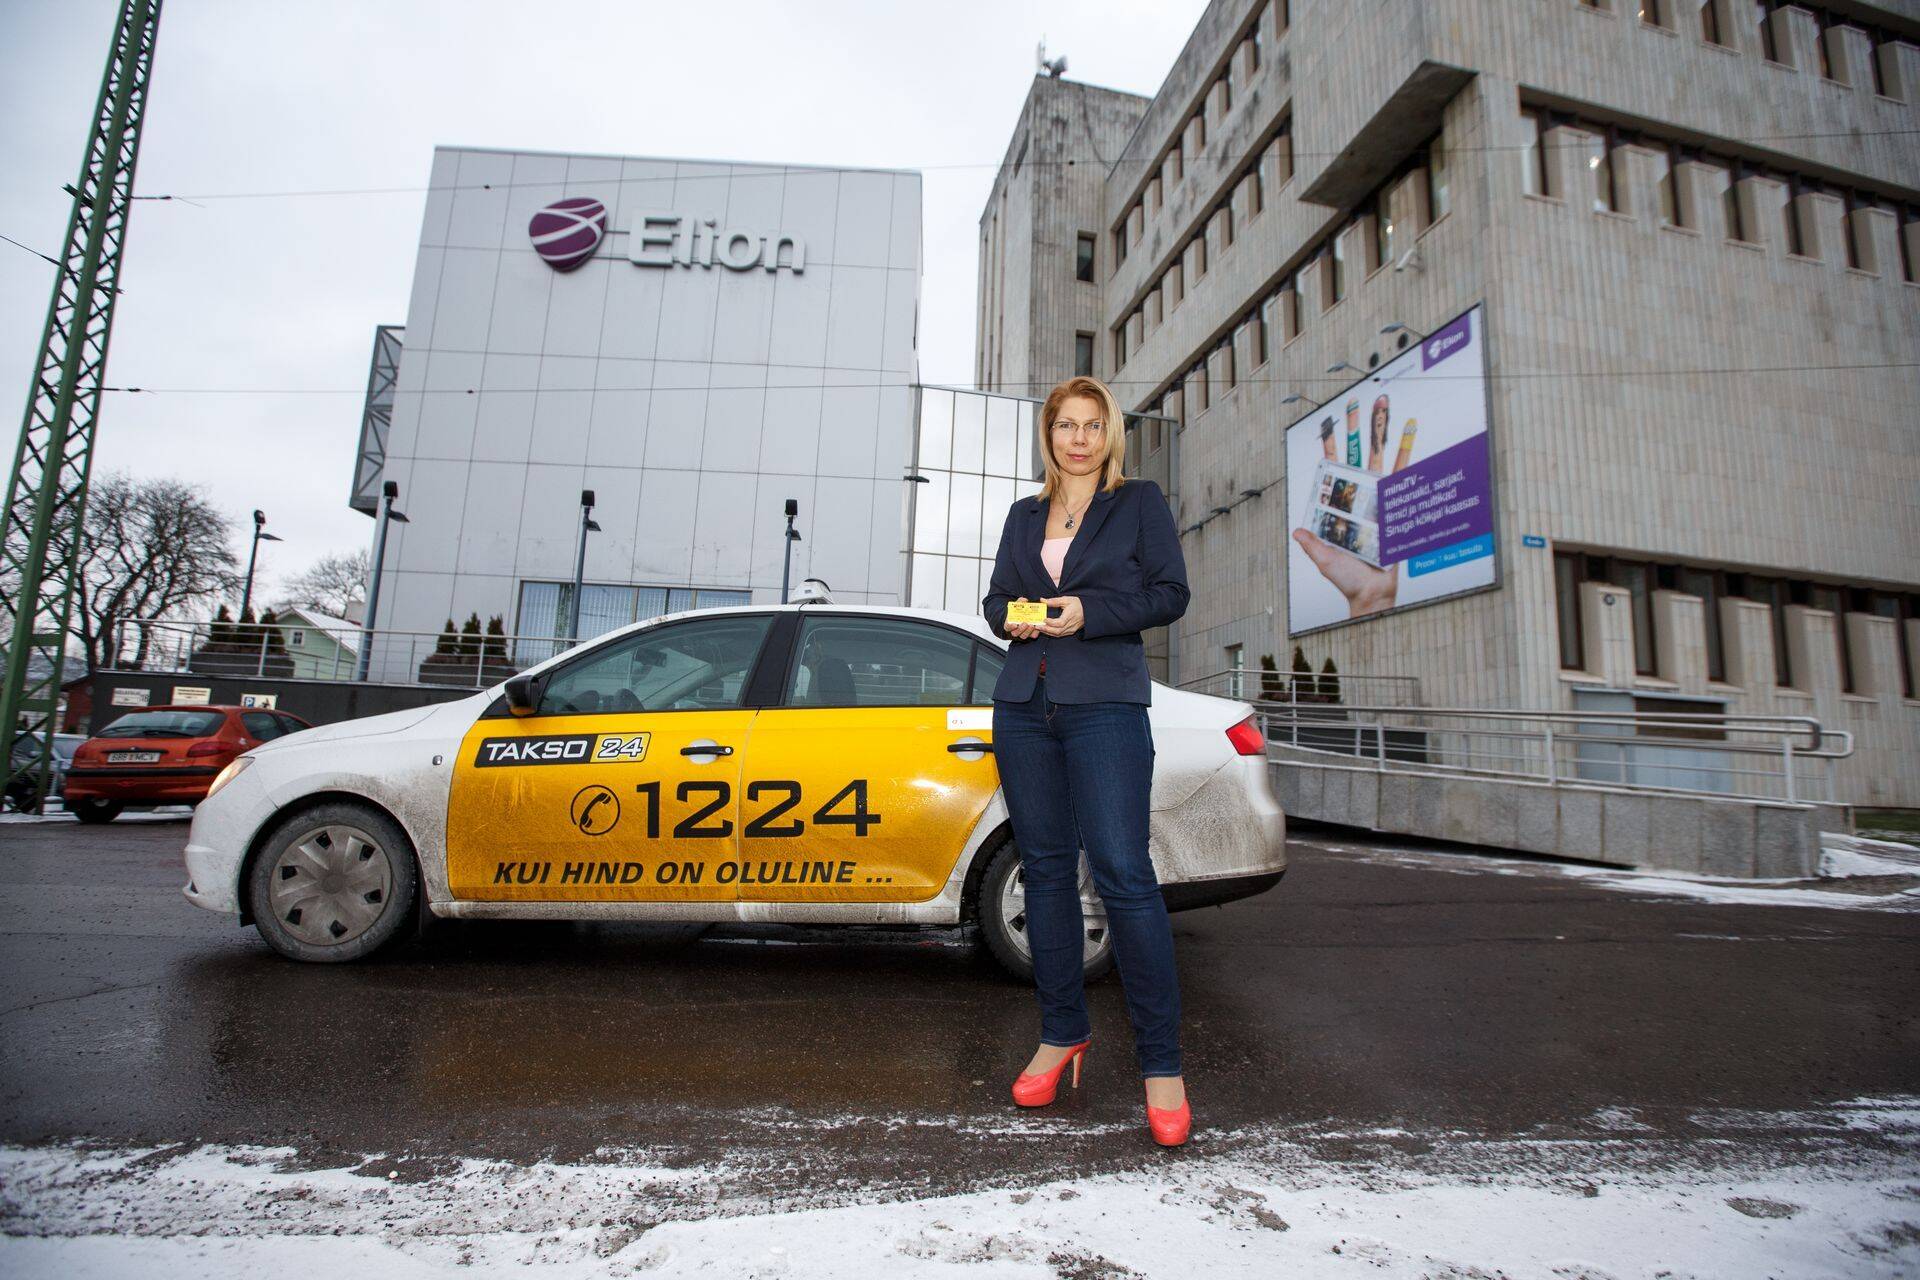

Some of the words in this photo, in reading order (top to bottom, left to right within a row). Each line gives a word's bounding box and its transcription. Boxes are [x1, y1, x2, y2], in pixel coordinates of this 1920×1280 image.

[629, 209, 808, 274] Elion
[486, 740, 588, 761] TAKSO
[597, 736, 644, 759] 24
[636, 779, 882, 839] 1224
[493, 862, 551, 885] KUI
[560, 861, 644, 884] HIND
[656, 861, 705, 884] ON
[719, 860, 857, 884] OLULINE
